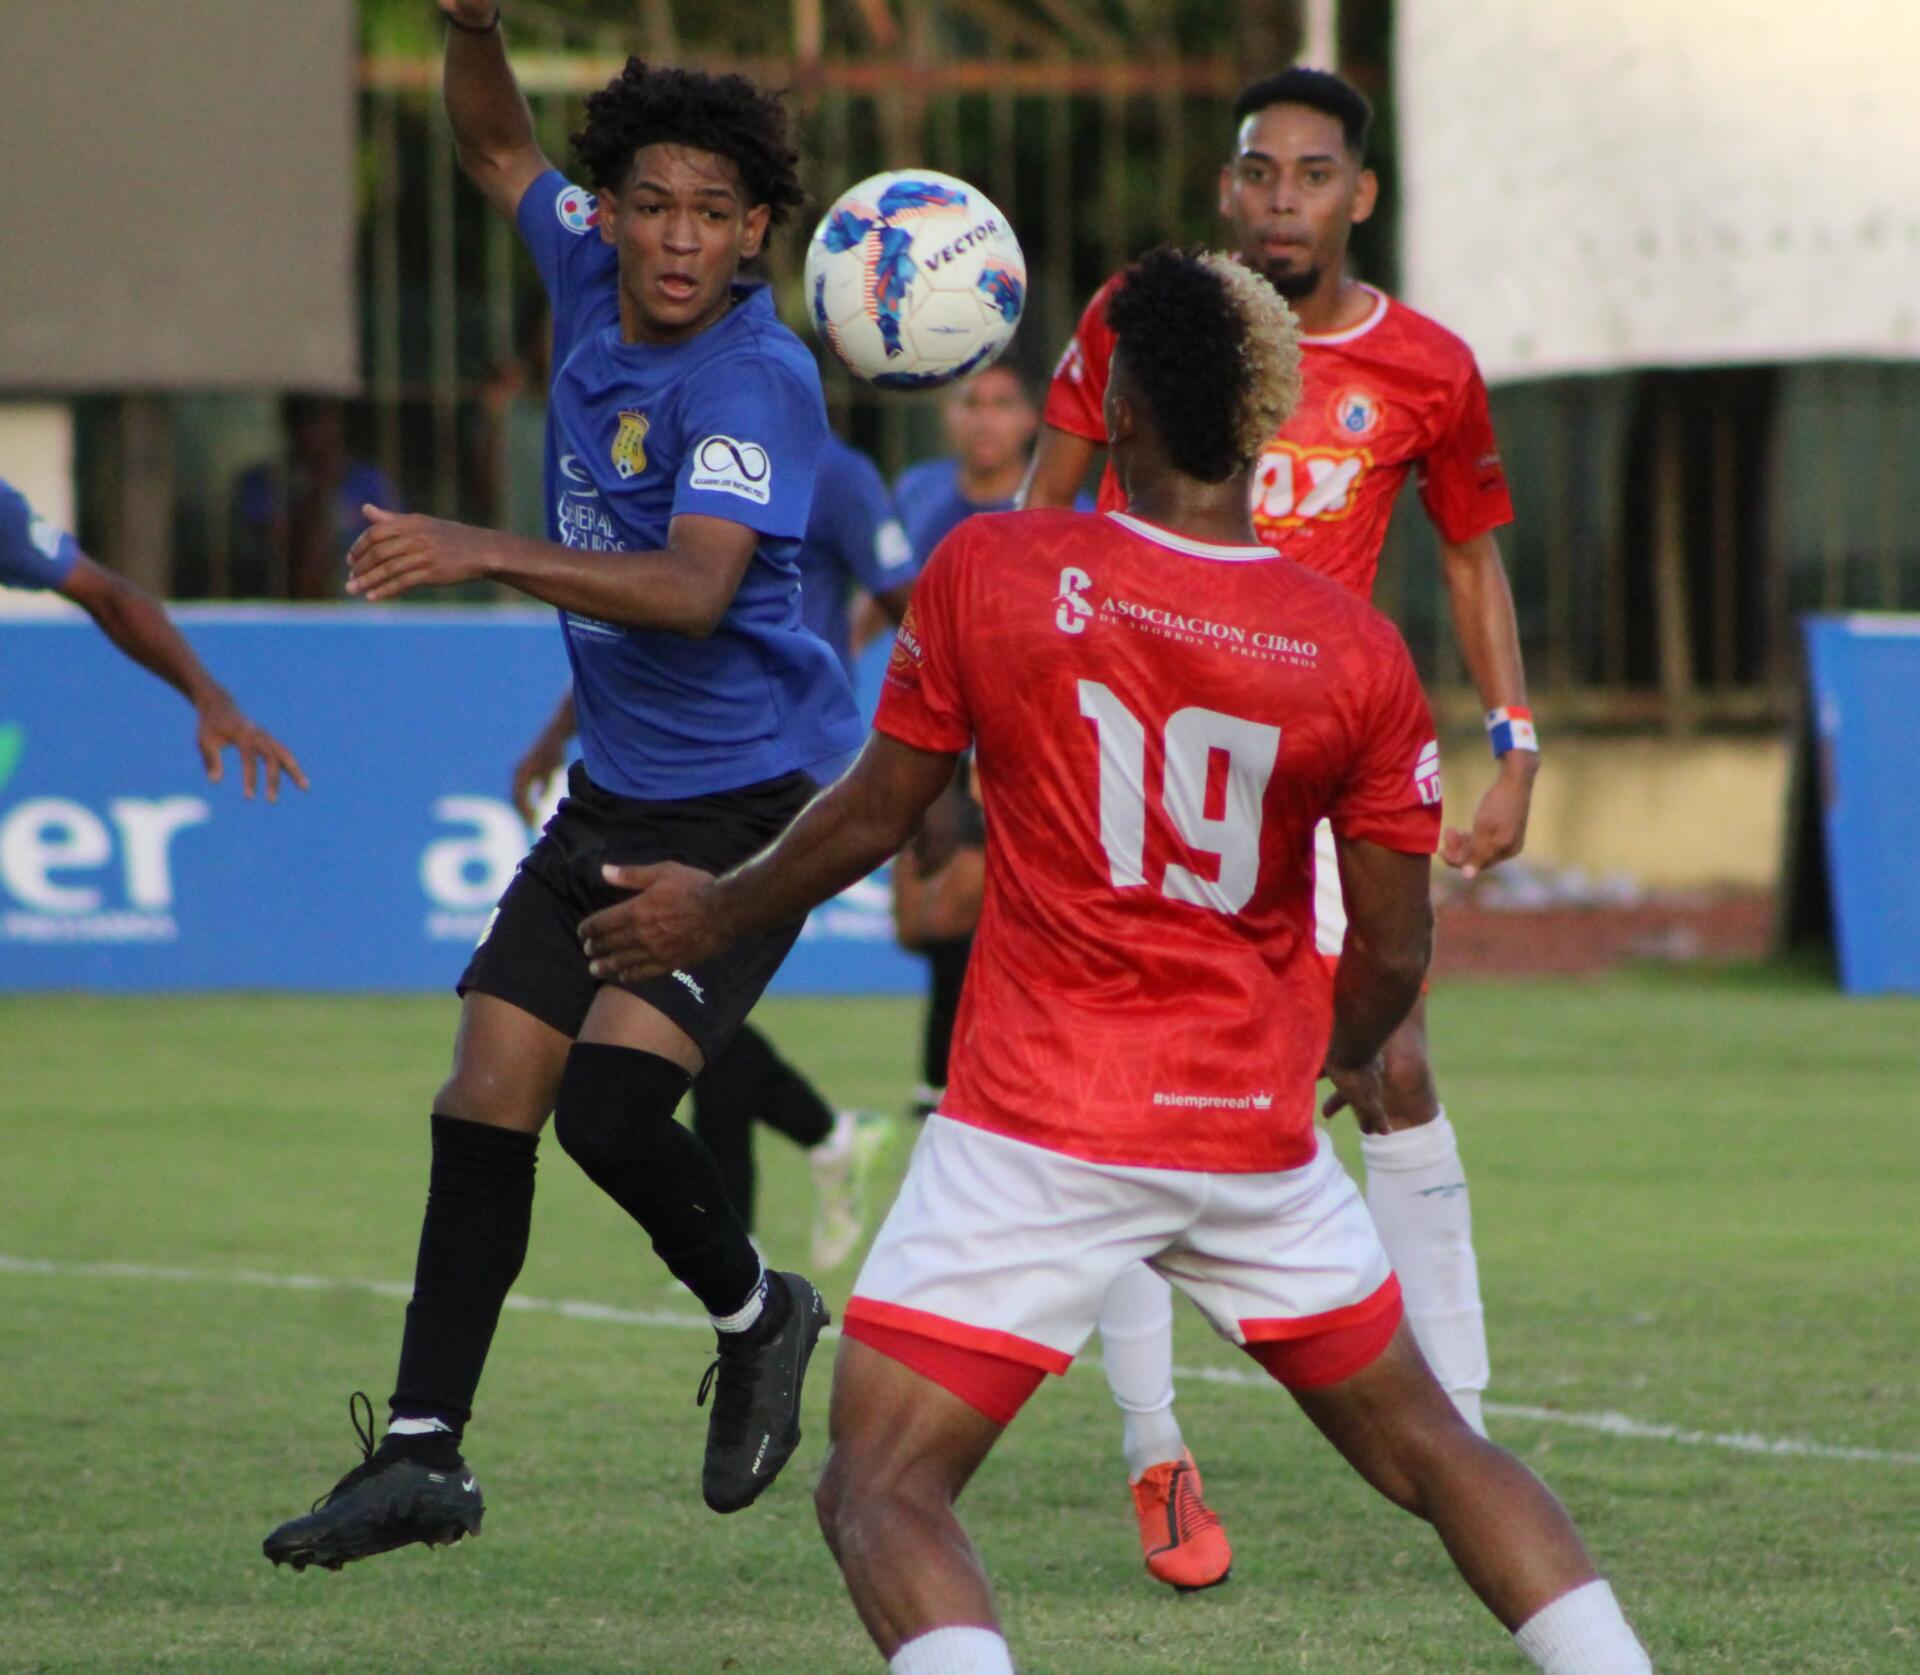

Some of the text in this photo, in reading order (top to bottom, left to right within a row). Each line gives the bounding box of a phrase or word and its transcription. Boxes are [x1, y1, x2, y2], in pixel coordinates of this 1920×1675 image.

[924, 219, 998, 271] VECTOR
[1101, 597, 1318, 657] ASOCIACION CIBAO
[1078, 680, 1281, 914] 19
[1153, 1092, 1250, 1109] #siemprereal
